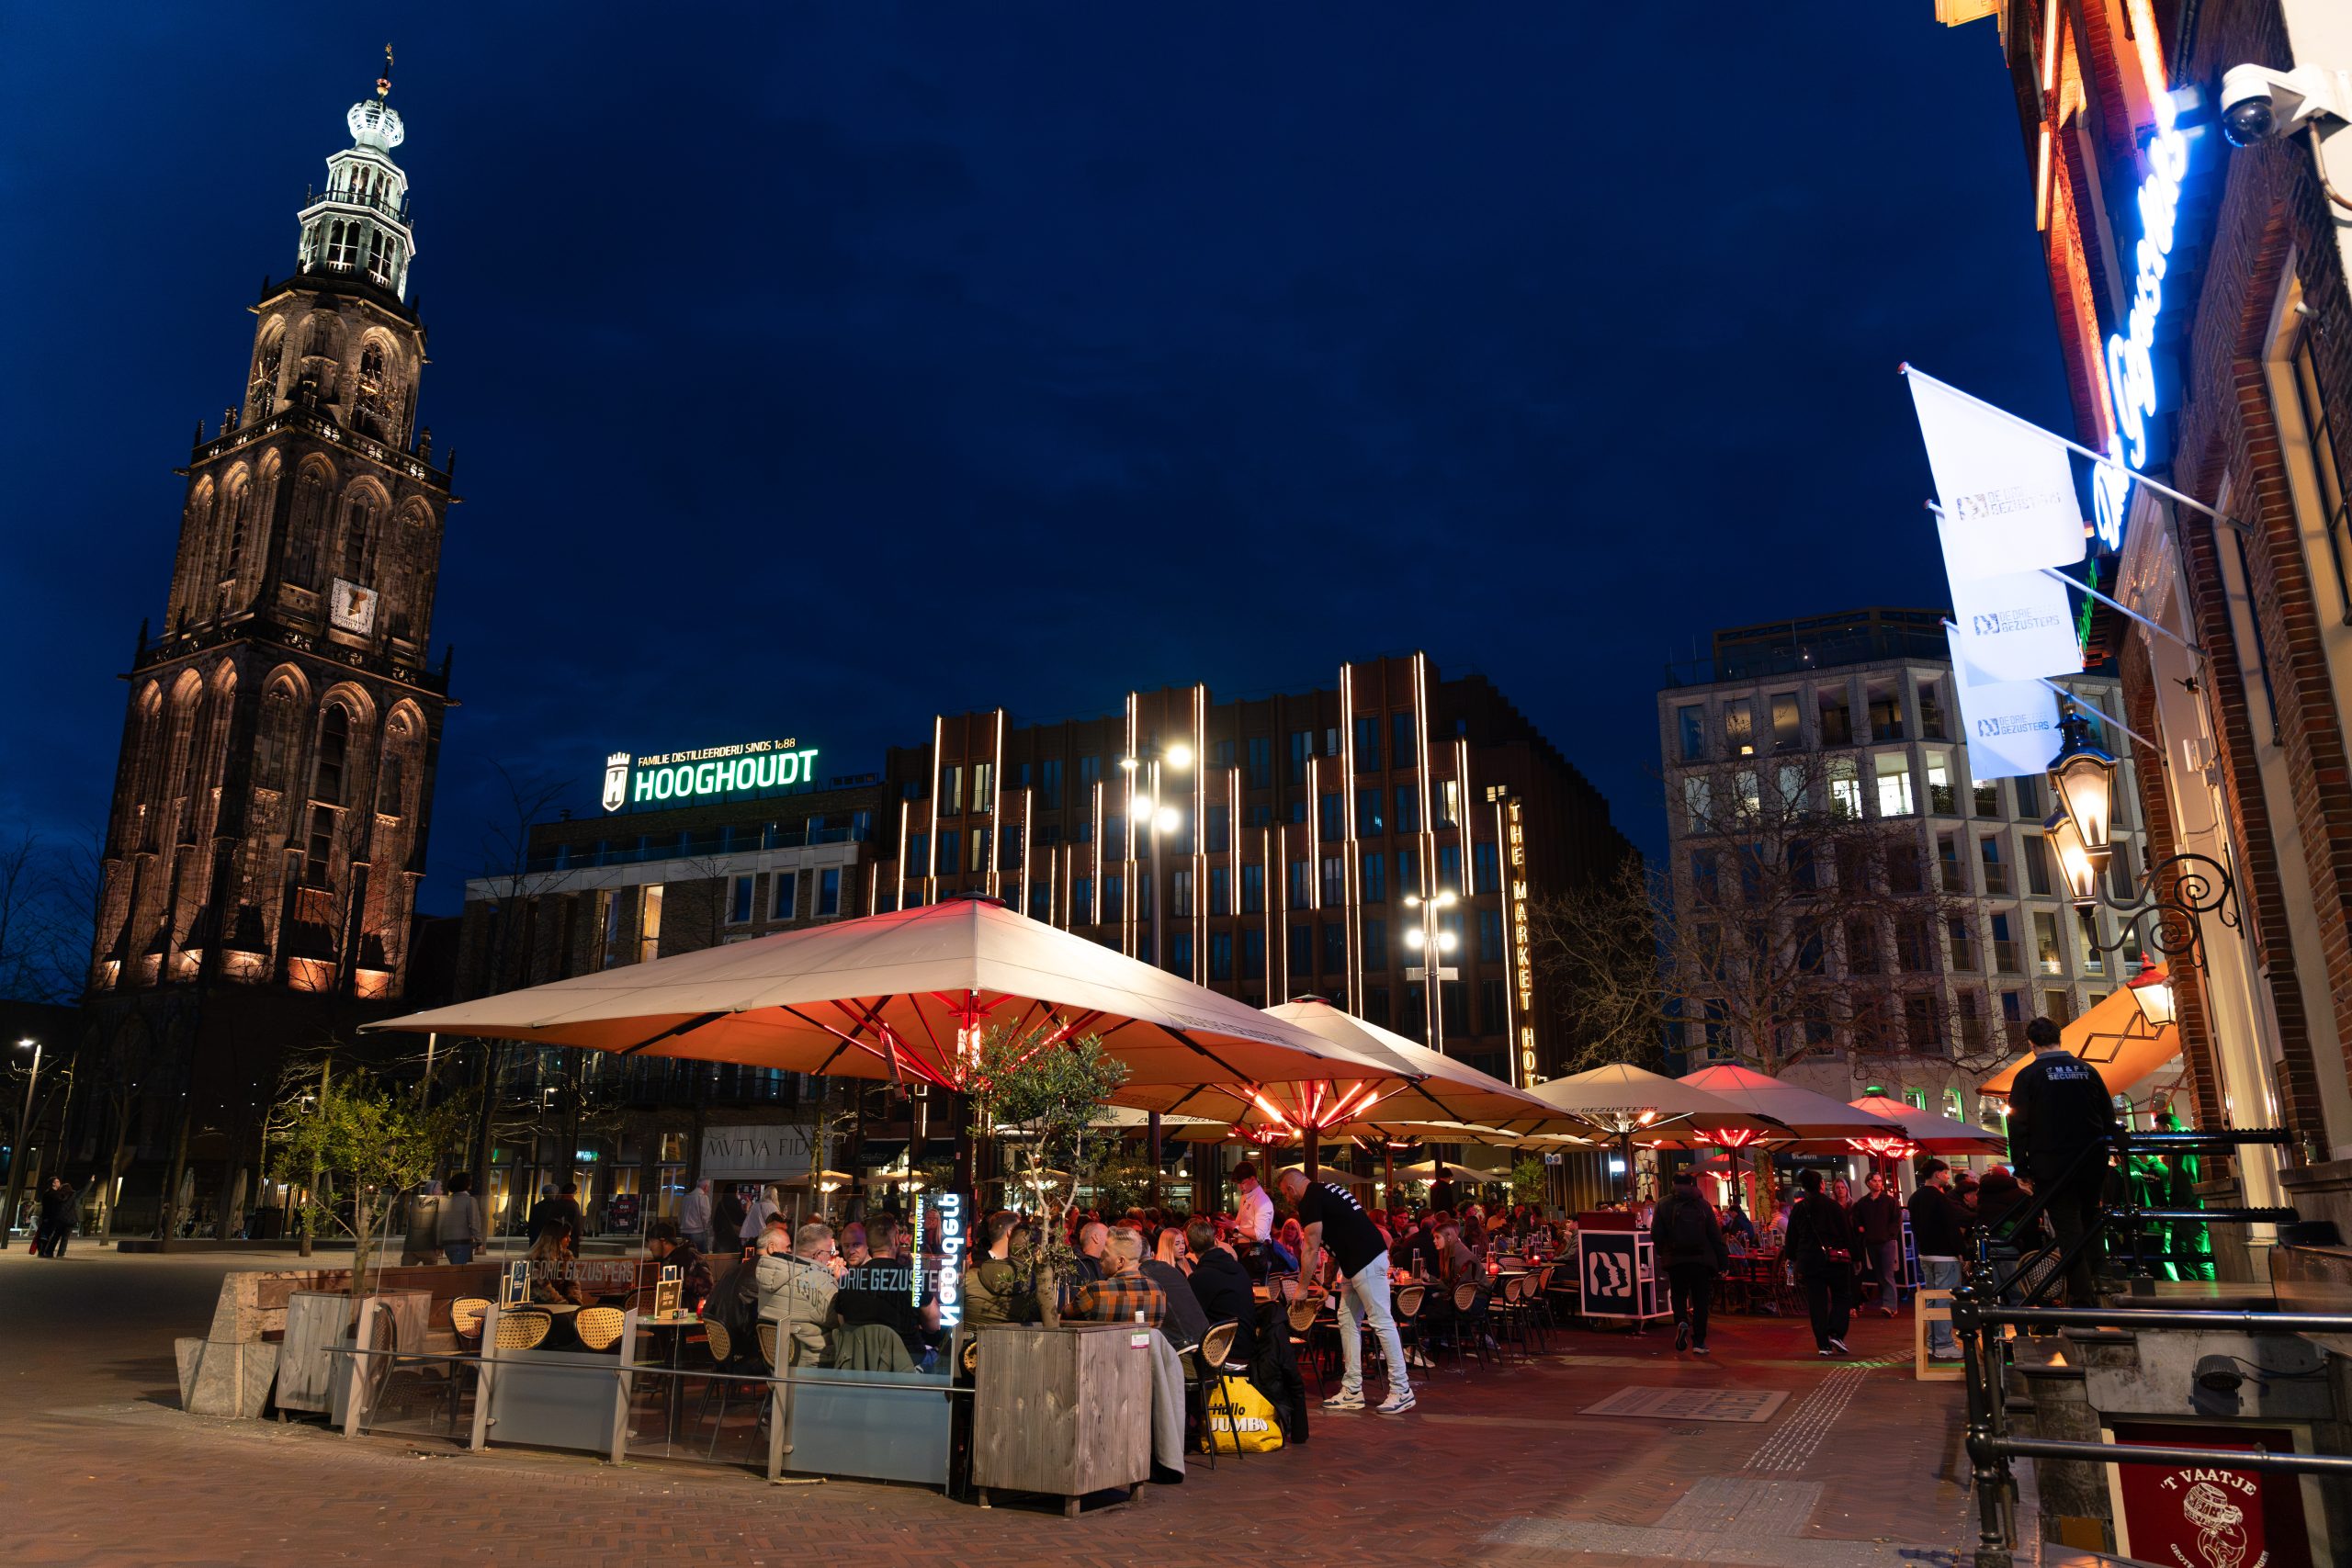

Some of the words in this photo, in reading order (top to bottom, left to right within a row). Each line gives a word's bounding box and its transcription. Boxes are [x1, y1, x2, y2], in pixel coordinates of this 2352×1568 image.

[1999, 610, 2011, 622] DE
[2012, 607, 2032, 620] DRIE
[2001, 615, 2060, 633] GEZUSTERS
[1999, 716, 2009, 726] DE
[2011, 714, 2027, 725] DRIE
[2001, 720, 2050, 735] GEZUSTERS
[638, 752, 671, 768] FAMILIE
[671, 743, 744, 763] DISTILLEERDERIJ
[745, 740, 772, 754] SINDS
[634, 750, 818, 802] HOOGHOUDT
[1509, 804, 1523, 865] THE
[1513, 881, 1532, 1011] MARKET
[2047, 1072, 2089, 1081] SECURITY
[705, 1138, 770, 1156] MVTVA
[539, 1260, 563, 1280] DRIE
[564, 1260, 634, 1282] GEZUSTERS
[839, 1268, 868, 1291] DRIE
[1210, 1417, 1269, 1433] JUMBO
[2160, 1476, 2178, 1491] 'T
[2178, 1468, 2256, 1496] VAATJE
